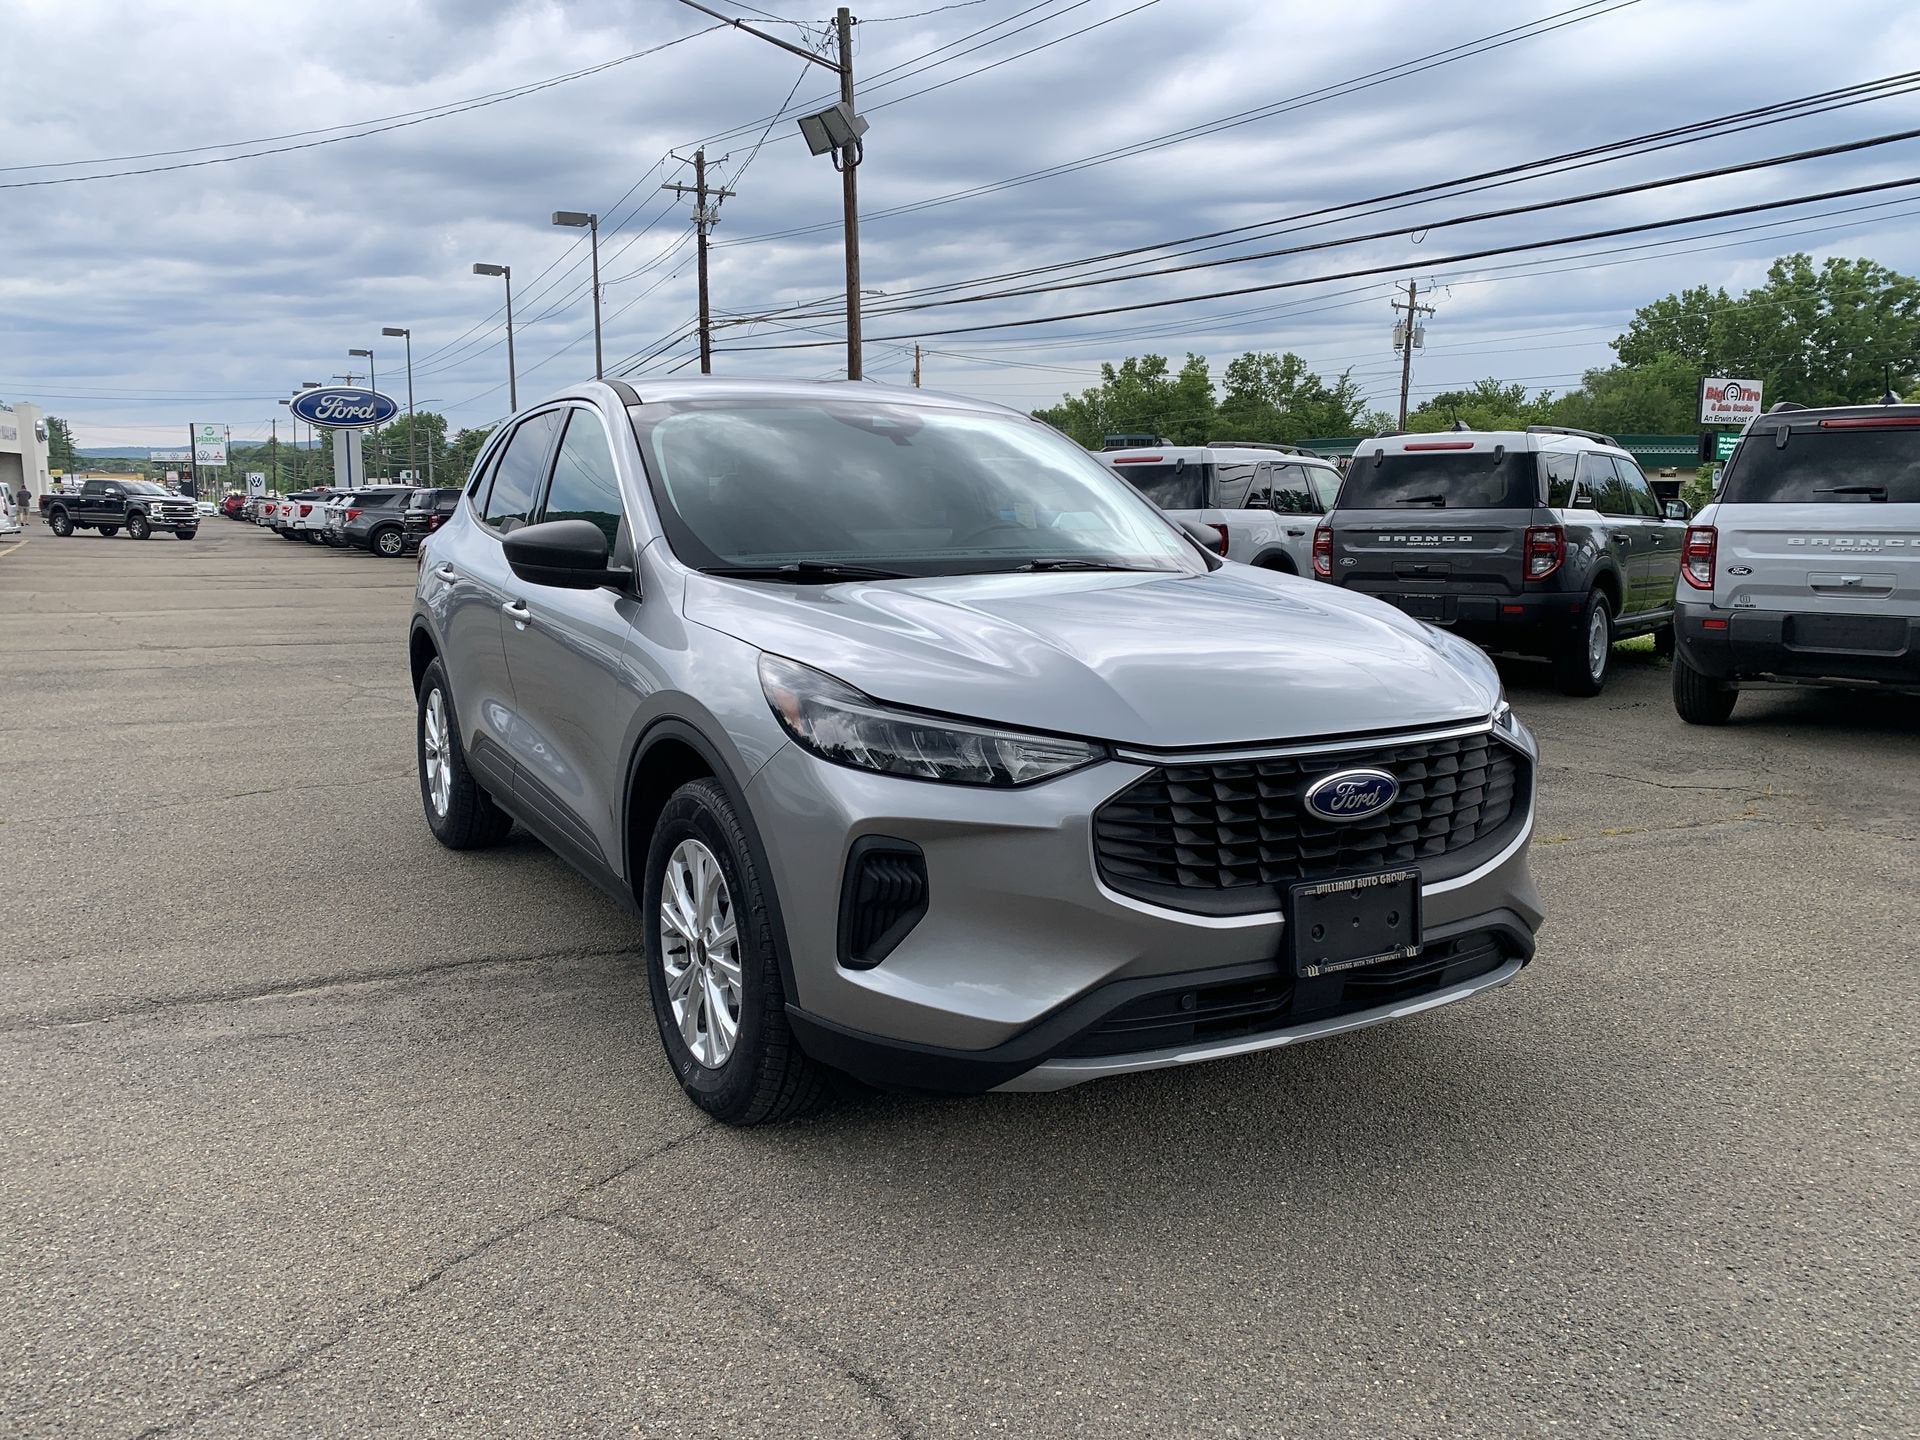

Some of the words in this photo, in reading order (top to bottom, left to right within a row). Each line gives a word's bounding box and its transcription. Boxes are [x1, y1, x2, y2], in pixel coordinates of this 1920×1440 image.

[1705, 386, 1724, 403] Big
[1740, 388, 1761, 401] Tire
[315, 394, 375, 419] Ford
[1717, 403, 1732, 412] Auto
[1732, 403, 1754, 412] Service
[1732, 415, 1748, 423] Kost
[196, 435, 225, 444] planet
[1731, 567, 1750, 575] Ford
[1330, 780, 1382, 811] Ford
[1357, 876, 1378, 888] AUTO
